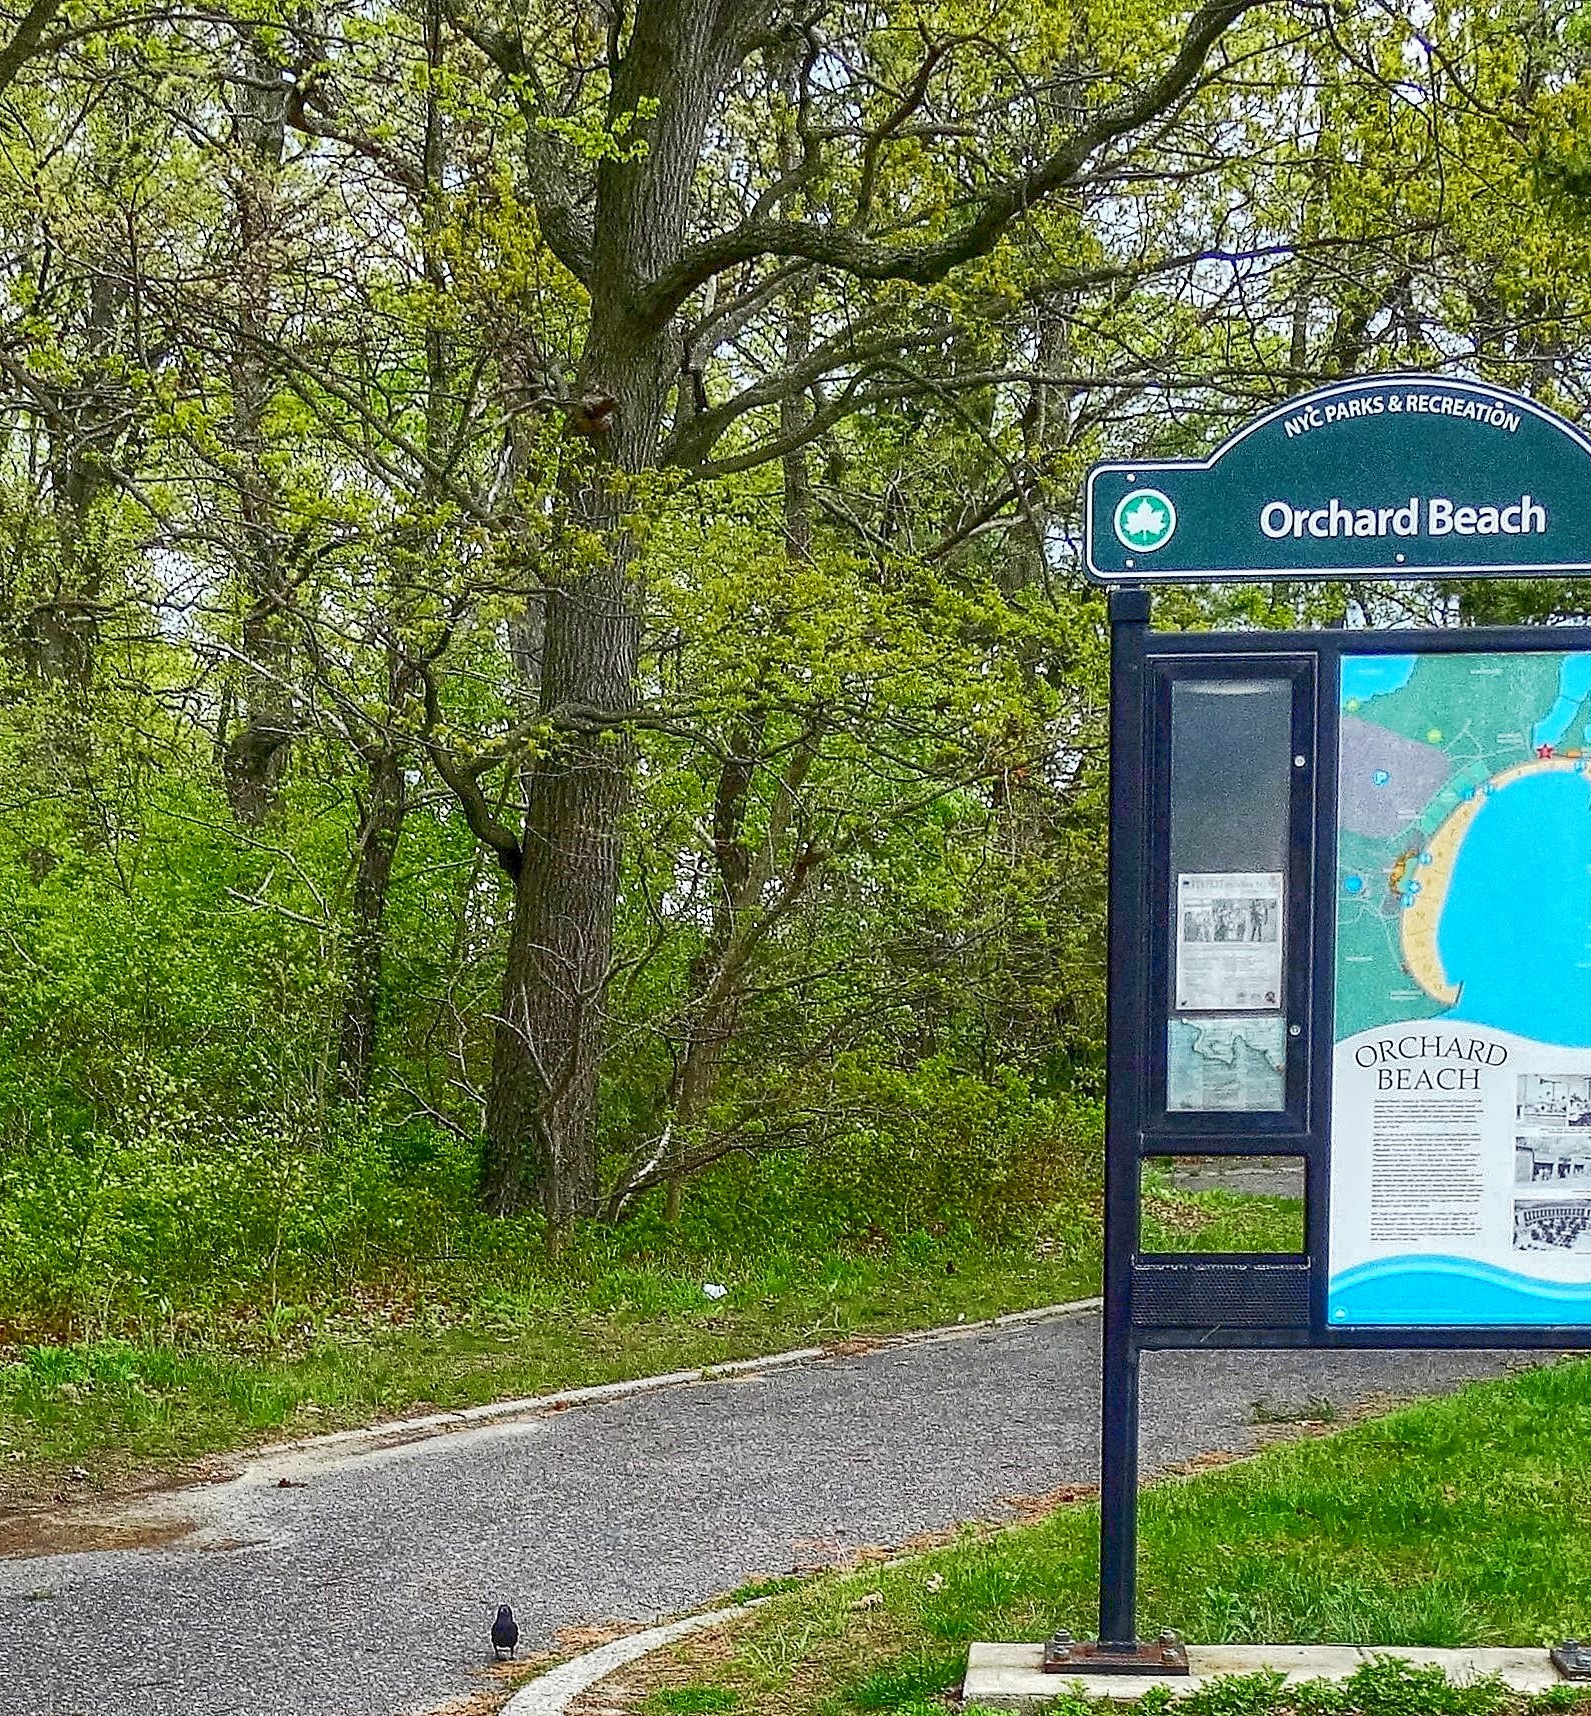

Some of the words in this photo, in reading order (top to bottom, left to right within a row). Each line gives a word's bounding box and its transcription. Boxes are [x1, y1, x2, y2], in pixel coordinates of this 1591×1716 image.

[1284, 410, 1324, 437] NYC
[1325, 396, 1384, 423] PARKS
[1388, 395, 1402, 412] &
[1406, 395, 1520, 432] RECREATION
[1260, 498, 1419, 538] Orchard
[1428, 495, 1546, 536] Beach
[1355, 1036, 1508, 1068] ORCHARD
[1378, 1068, 1481, 1090] BEACH
